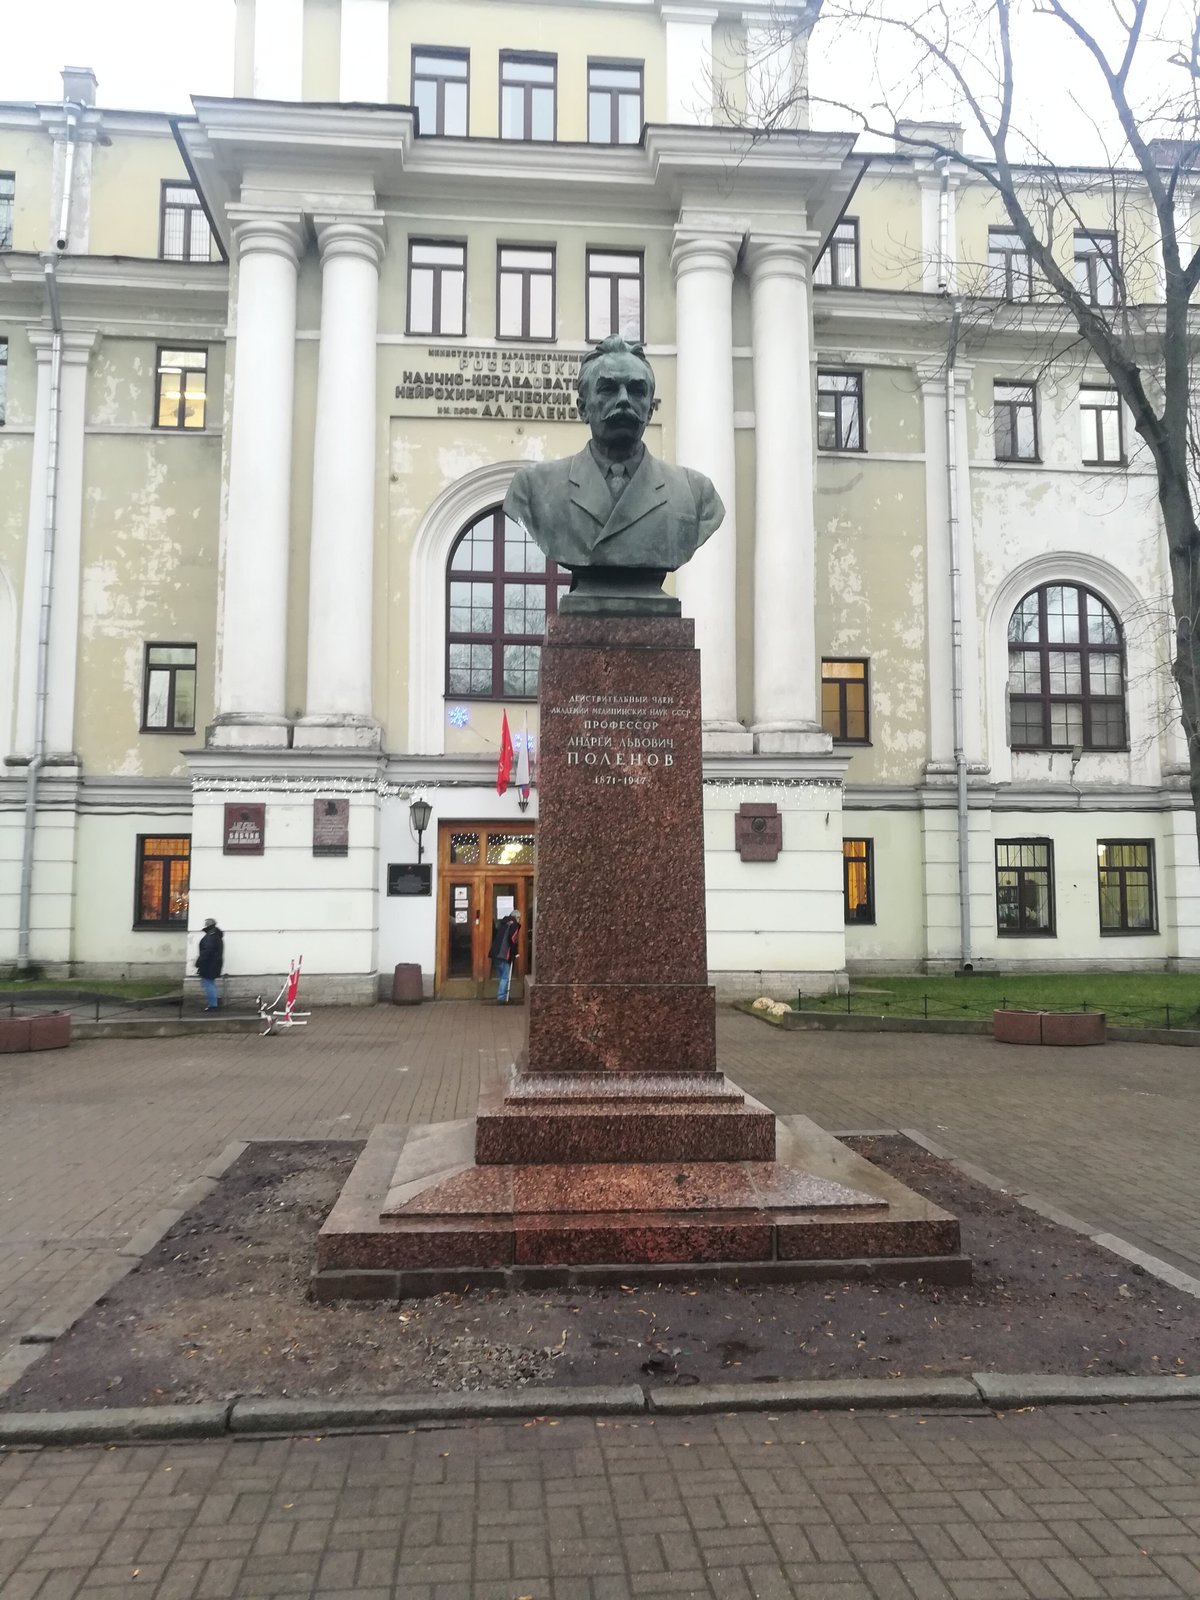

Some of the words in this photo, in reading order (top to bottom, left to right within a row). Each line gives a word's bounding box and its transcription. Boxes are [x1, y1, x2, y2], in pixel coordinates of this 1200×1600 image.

[460, 359, 578, 376] РОССИЙСКИ
[402, 370, 578, 391] НАУЧНО-ИССЛЕДОВАТЕ
[512, 405, 577, 419] ПОЛЕНО
[569, 695, 648, 704] ДЕЙСТВИТЕЛЬНЫЙ
[651, 696, 674, 704] ЧЛЕН
[551, 707, 589, 715] АКАДЕМИИ
[592, 707, 647, 716] МЕДИЦИНСКИХ
[650, 709, 668, 717] НАУК
[671, 709, 691, 718] СССР
[584, 720, 659, 730] ПРОФЕССОР
[567, 736, 612, 748] АНДРЕЙ
[619, 737, 674, 748] ЛЬВОВИЧ
[567, 752, 674, 766] ПОЛЕНОВ
